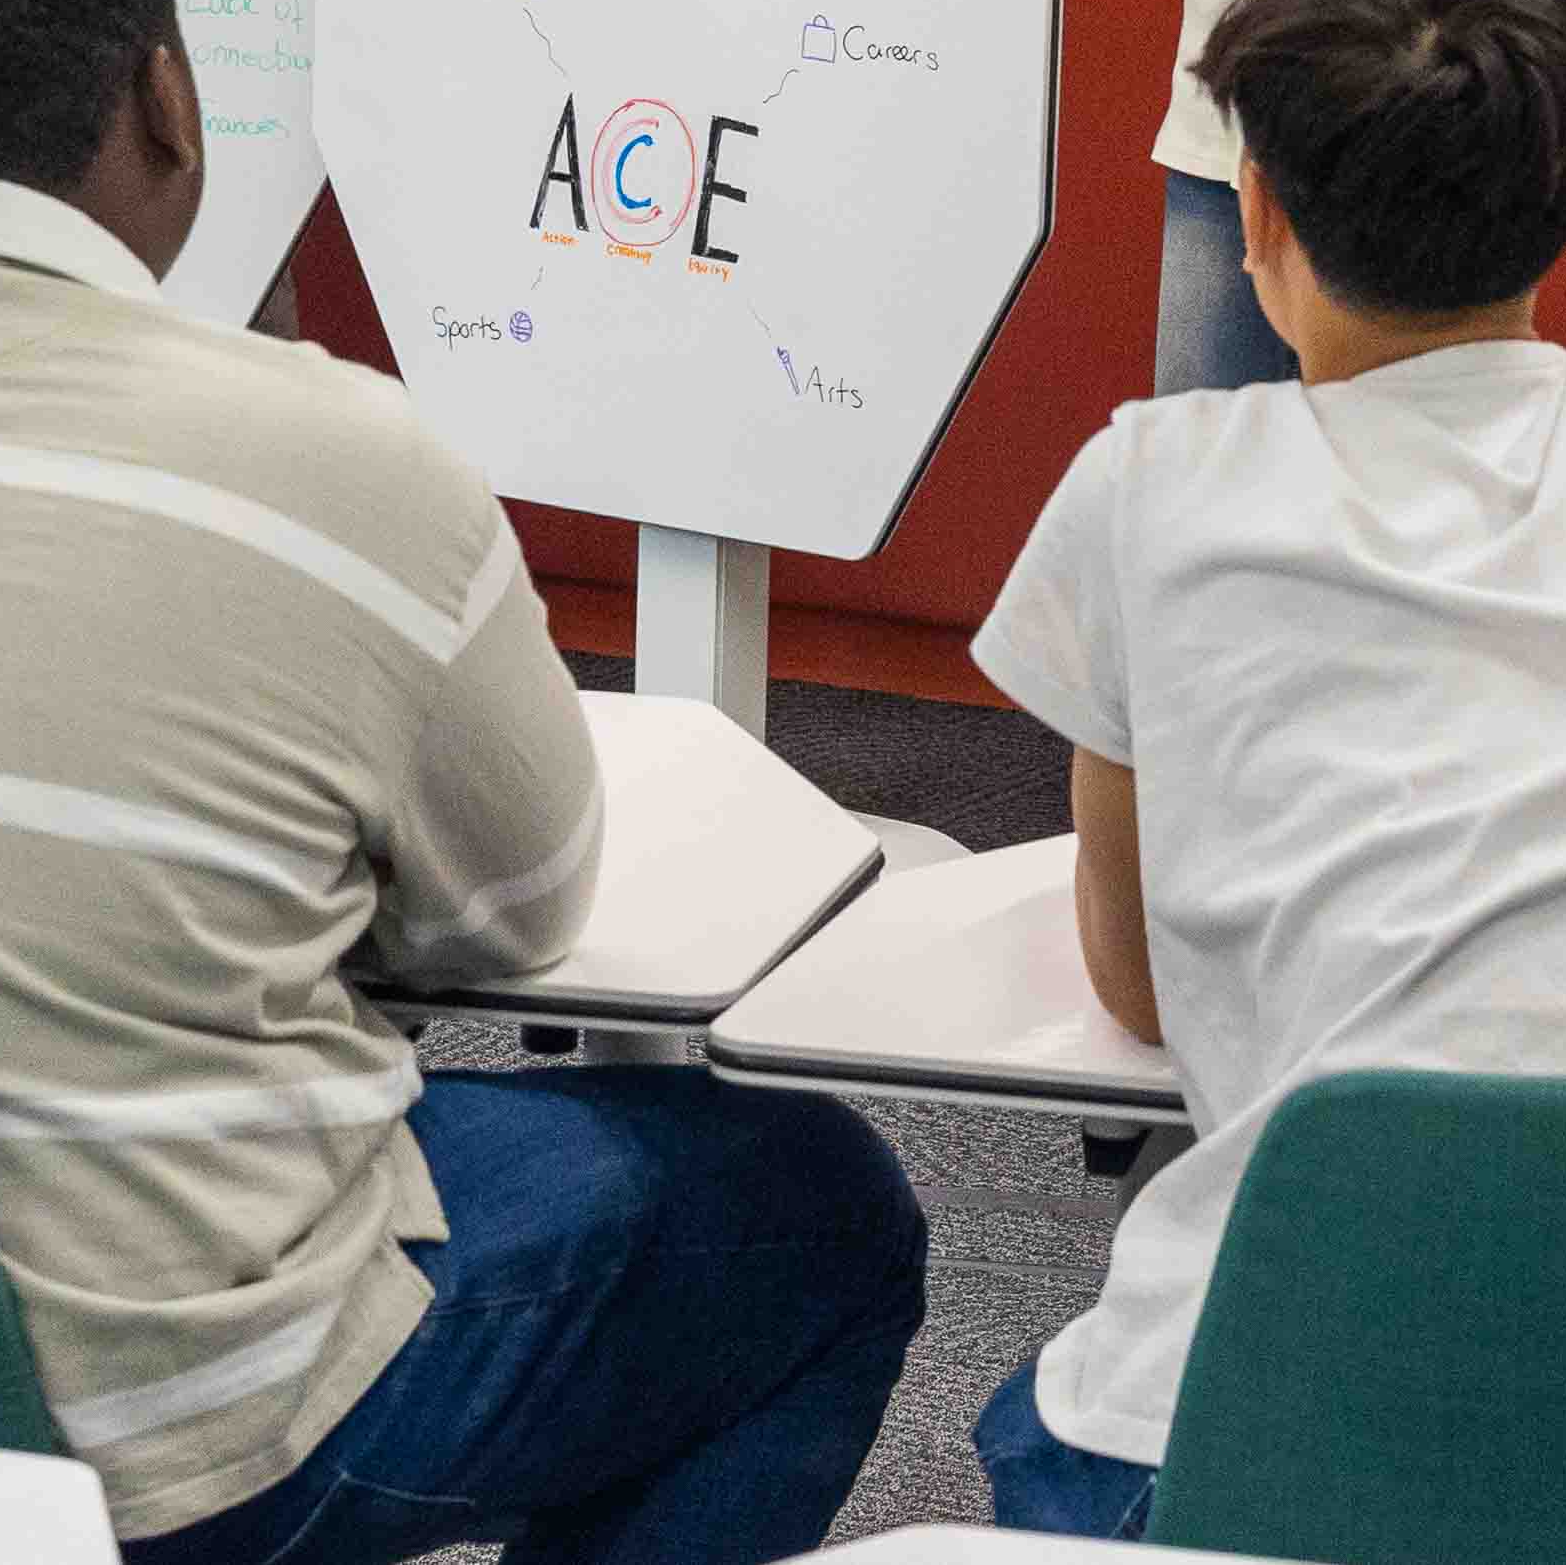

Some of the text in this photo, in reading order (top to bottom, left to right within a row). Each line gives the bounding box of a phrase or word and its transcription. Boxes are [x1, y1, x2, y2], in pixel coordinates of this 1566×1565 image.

[842, 24, 940, 72] Careers
[529, 92, 760, 265] ACE
[431, 305, 503, 352] Sports
[803, 365, 864, 409] Arts
